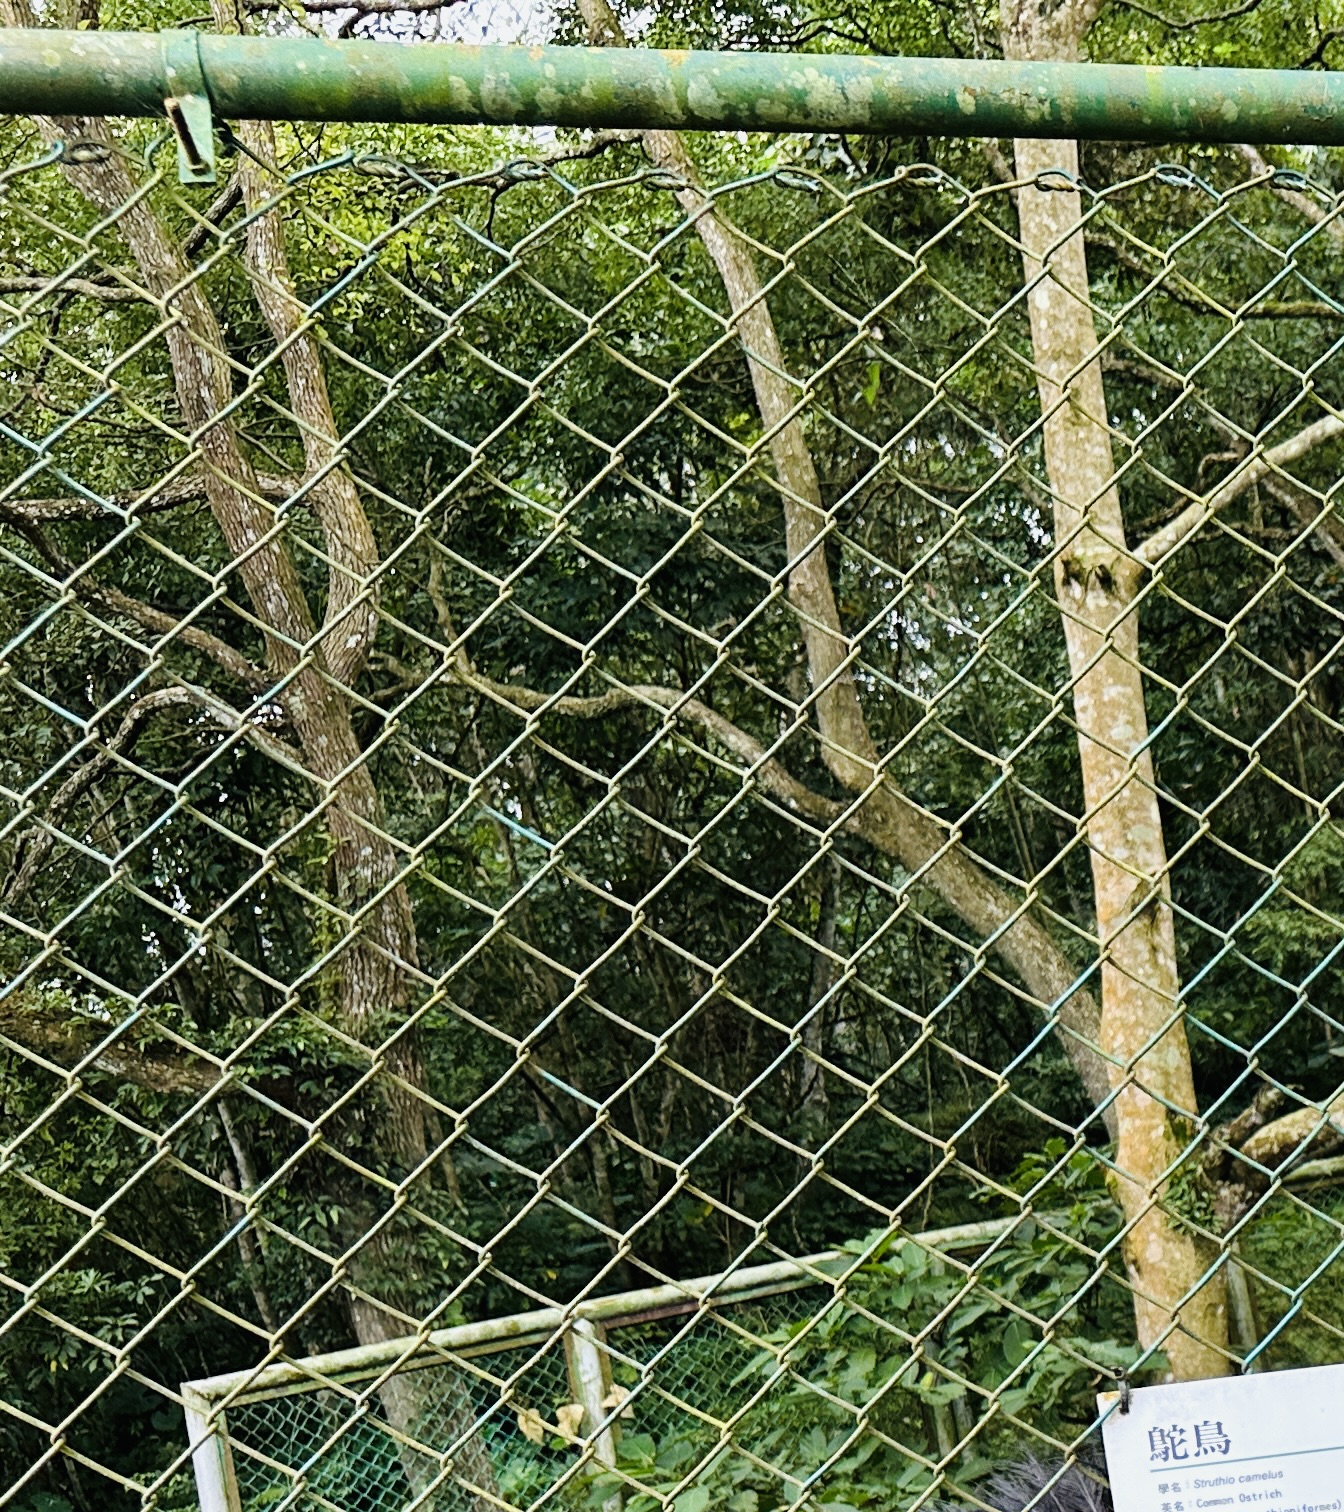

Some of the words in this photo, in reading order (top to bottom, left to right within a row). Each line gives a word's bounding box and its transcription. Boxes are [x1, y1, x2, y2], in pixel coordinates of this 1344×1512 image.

[1147, 1420, 1232, 1462] 鴕鳥
[1238, 1470, 1284, 1484] camelus
[1239, 1488, 1283, 1503] Ostrich
